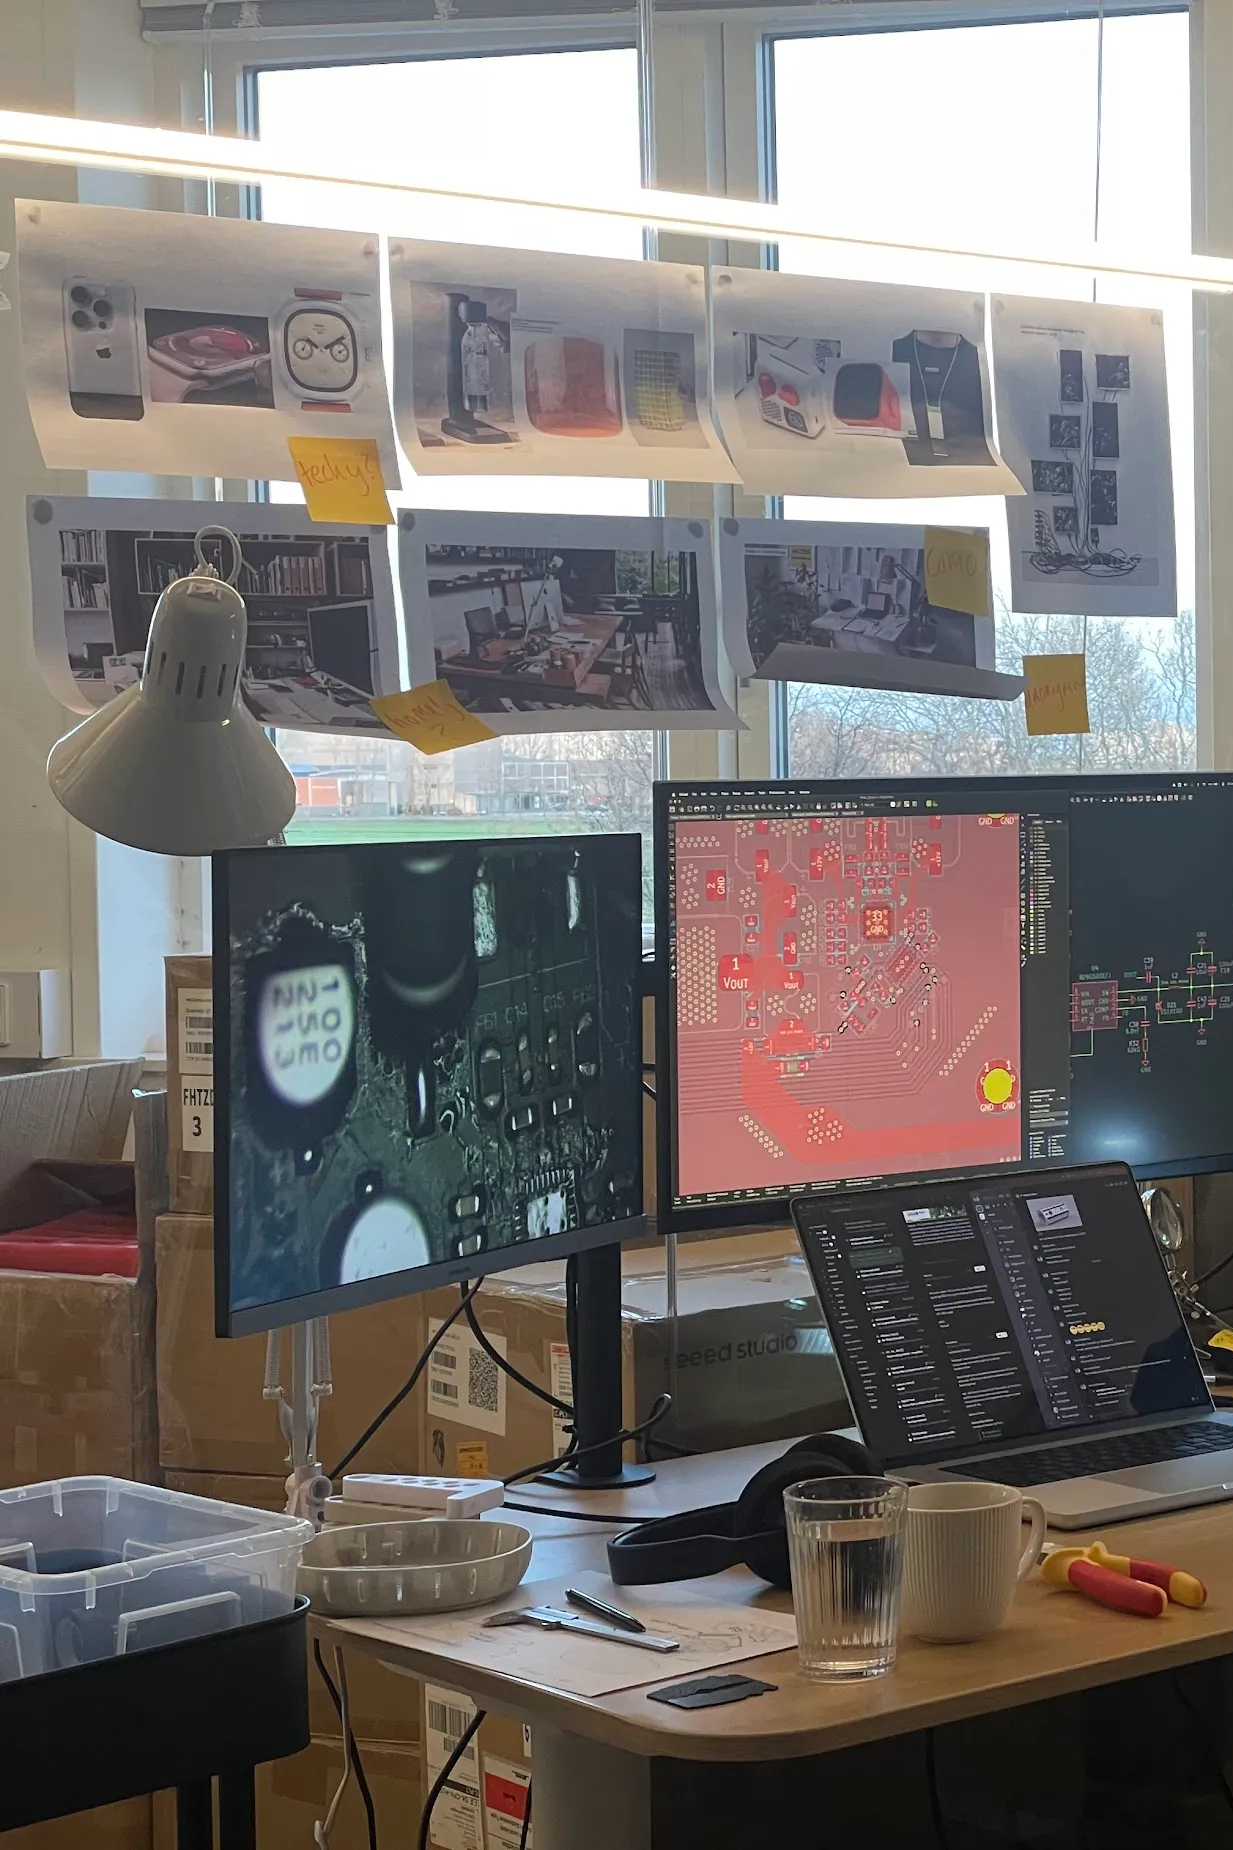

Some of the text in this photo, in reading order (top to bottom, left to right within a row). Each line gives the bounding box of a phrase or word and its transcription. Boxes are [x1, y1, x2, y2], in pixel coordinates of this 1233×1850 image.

[297, 452, 375, 497] techy?
[978, 816, 1015, 826] GND GND
[716, 876, 726, 895] GND
[871, 911, 883, 921] 33
[731, 957, 740, 971] 1
[192, 1116, 202, 1137] 3
[736, 1333, 798, 1360] studio
